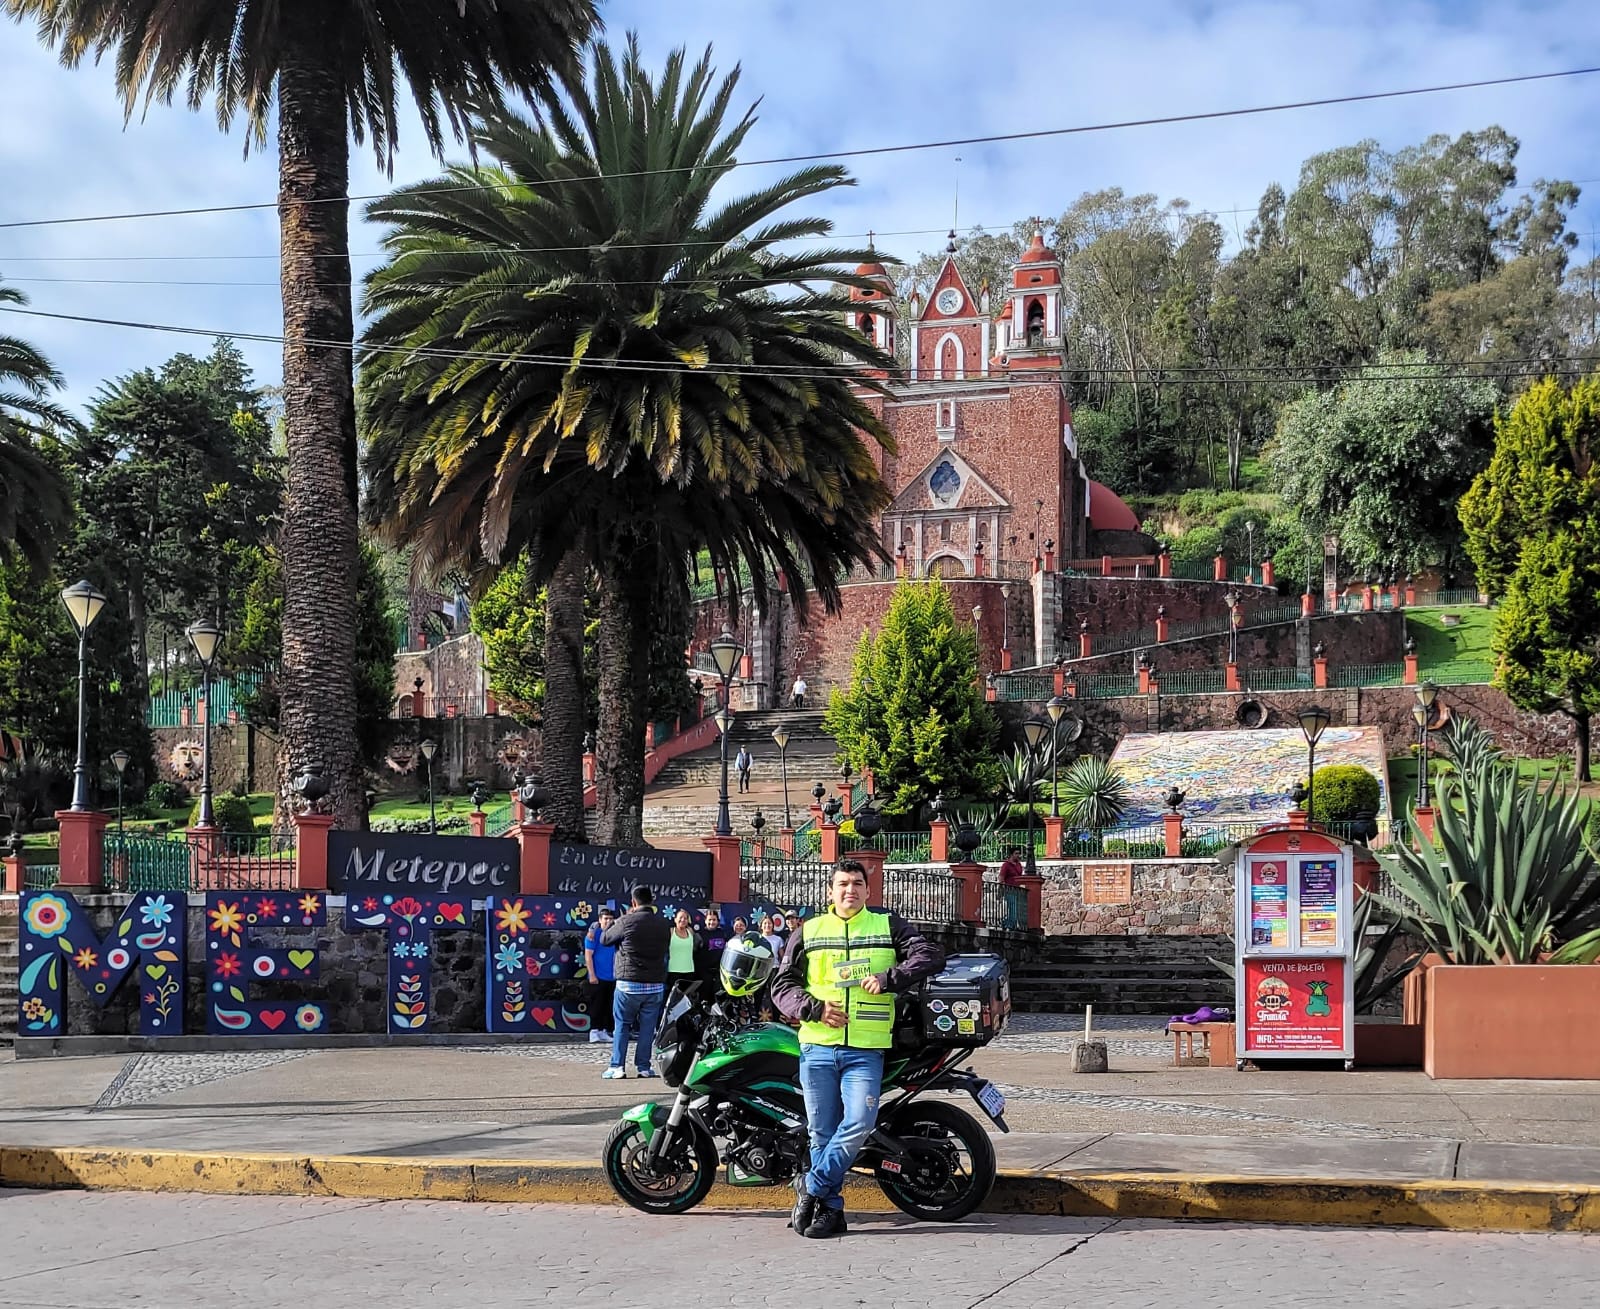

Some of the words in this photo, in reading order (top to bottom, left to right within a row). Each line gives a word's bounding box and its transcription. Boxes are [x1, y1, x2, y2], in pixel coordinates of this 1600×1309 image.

[559, 846, 585, 864] En
[592, 849, 609, 866] el
[615, 849, 666, 869] Cerro
[341, 846, 511, 894] Metepec
[558, 875, 580, 893] de
[585, 876, 612, 894] los
[620, 877, 707, 901] Mgueyes
[1262, 963, 1285, 973] VENTA
[1287, 963, 1296, 972] DE
[1297, 963, 1325, 973] BOLETOS
[1256, 1035, 1275, 1044] INFO:
[883, 1161, 900, 1171] RK
